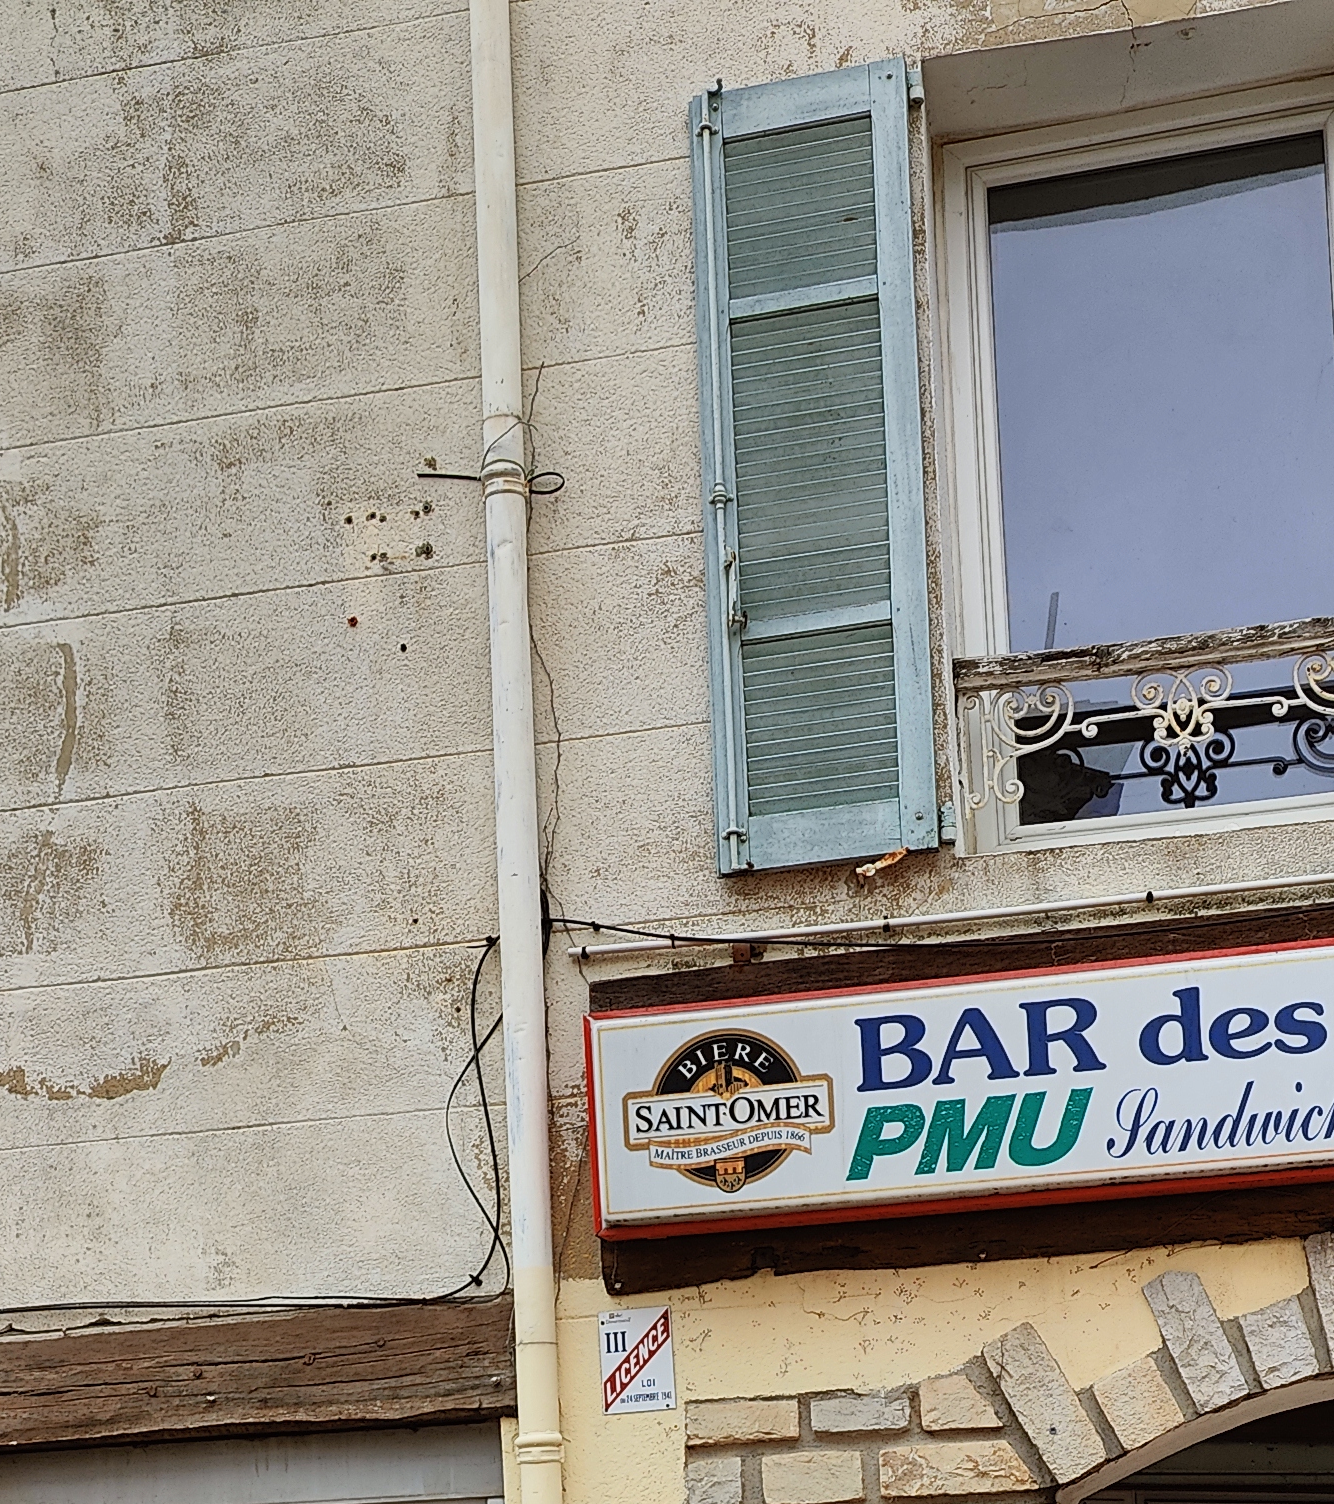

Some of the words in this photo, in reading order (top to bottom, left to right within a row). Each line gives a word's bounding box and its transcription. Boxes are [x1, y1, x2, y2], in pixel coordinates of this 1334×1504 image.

[854, 996, 1107, 1093] BAR
[1138, 986, 1329, 1066] des
[676, 1042, 774, 1080] BIERE
[695, 1135, 747, 1159] BRASSEUR
[748, 1129, 783, 1144] DEPUIS
[785, 1129, 806, 1142] 1866
[845, 1086, 1094, 1182] PMU
[604, 1331, 628, 1354] III
[606, 1317, 667, 1404] LICENCE
[641, 1379, 656, 1388] LOI
